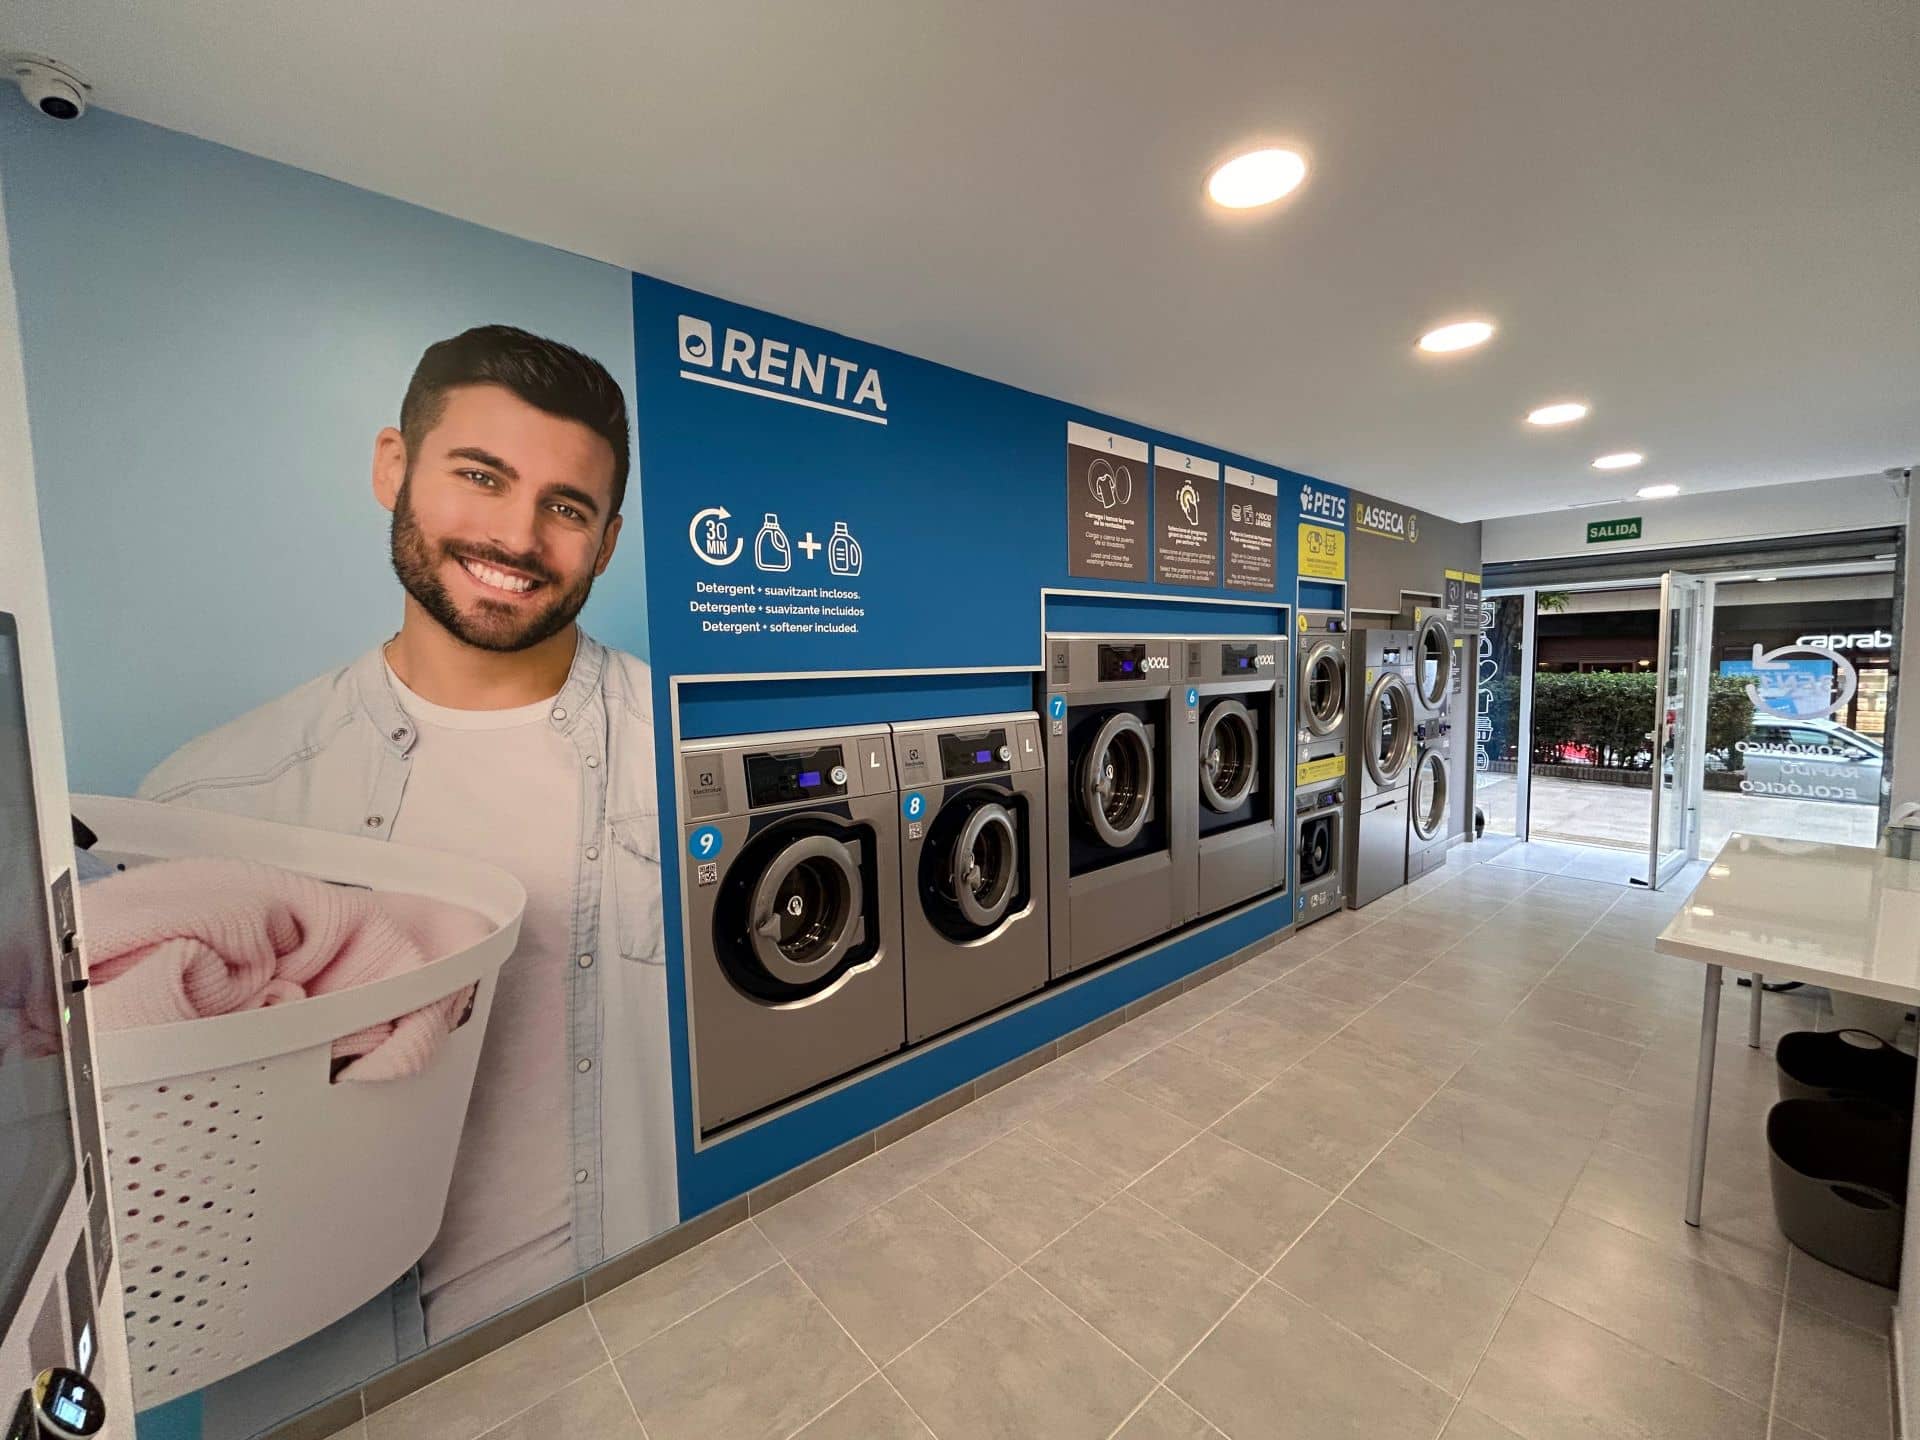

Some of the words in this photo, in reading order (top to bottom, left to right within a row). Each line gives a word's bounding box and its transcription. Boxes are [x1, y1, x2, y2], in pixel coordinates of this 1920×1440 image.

[721, 327, 888, 412] RENTA
[1107, 437, 1113, 449] 1
[1185, 457, 1191, 469] 2
[1313, 491, 1345, 520] PETS
[1363, 505, 1405, 536] ASSECA
[705, 520, 728, 541] 30
[1589, 523, 1638, 538] SALIDA
[706, 539, 728, 556] MIN
[696, 581, 755, 597] Detergent
[764, 587, 818, 599] suavitzant
[819, 589, 861, 600] inclosos.
[689, 601, 756, 616] Detergente
[765, 604, 821, 616] suavizante
[702, 620, 761, 635] Detergent
[769, 622, 813, 633] softener
[814, 622, 859, 633] included.
[1189, 691, 1196, 703] 6
[1054, 700, 1061, 715] 7
[1025, 739, 1033, 753] L
[870, 752, 881, 769] L
[909, 797, 920, 815] 8
[699, 833, 714, 855] 9
